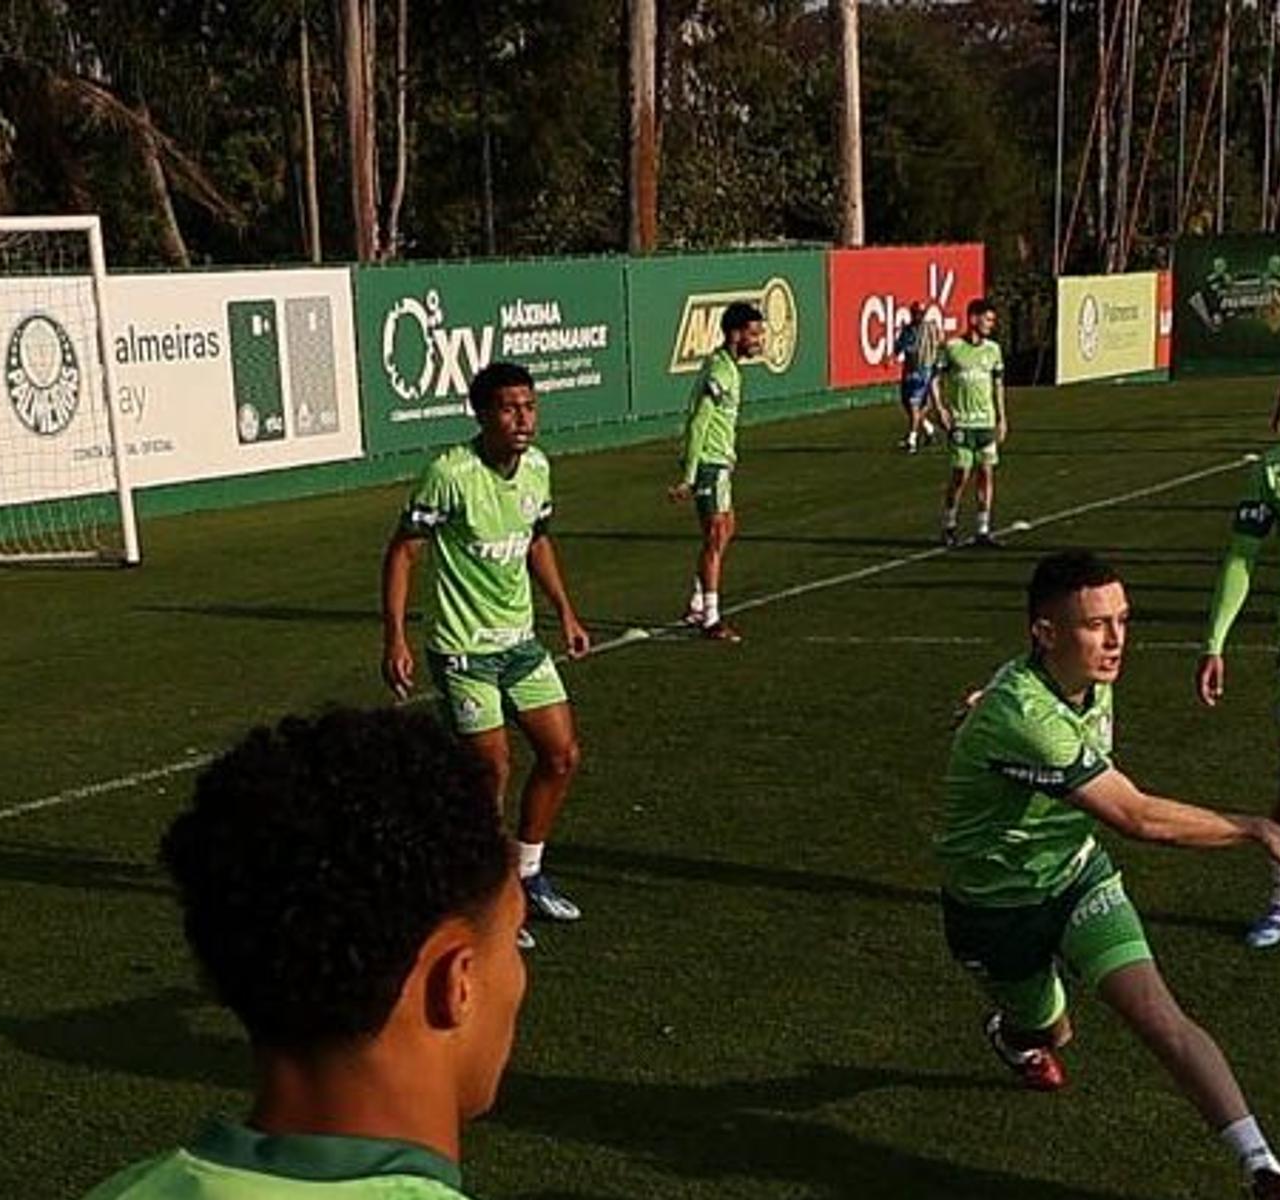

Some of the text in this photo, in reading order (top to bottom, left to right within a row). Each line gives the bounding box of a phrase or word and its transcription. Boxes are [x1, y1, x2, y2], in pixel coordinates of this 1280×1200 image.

[114, 322, 221, 365] almeiras
[502, 325, 608, 356] PERFORMANCE
[118, 385, 147, 424] ay
